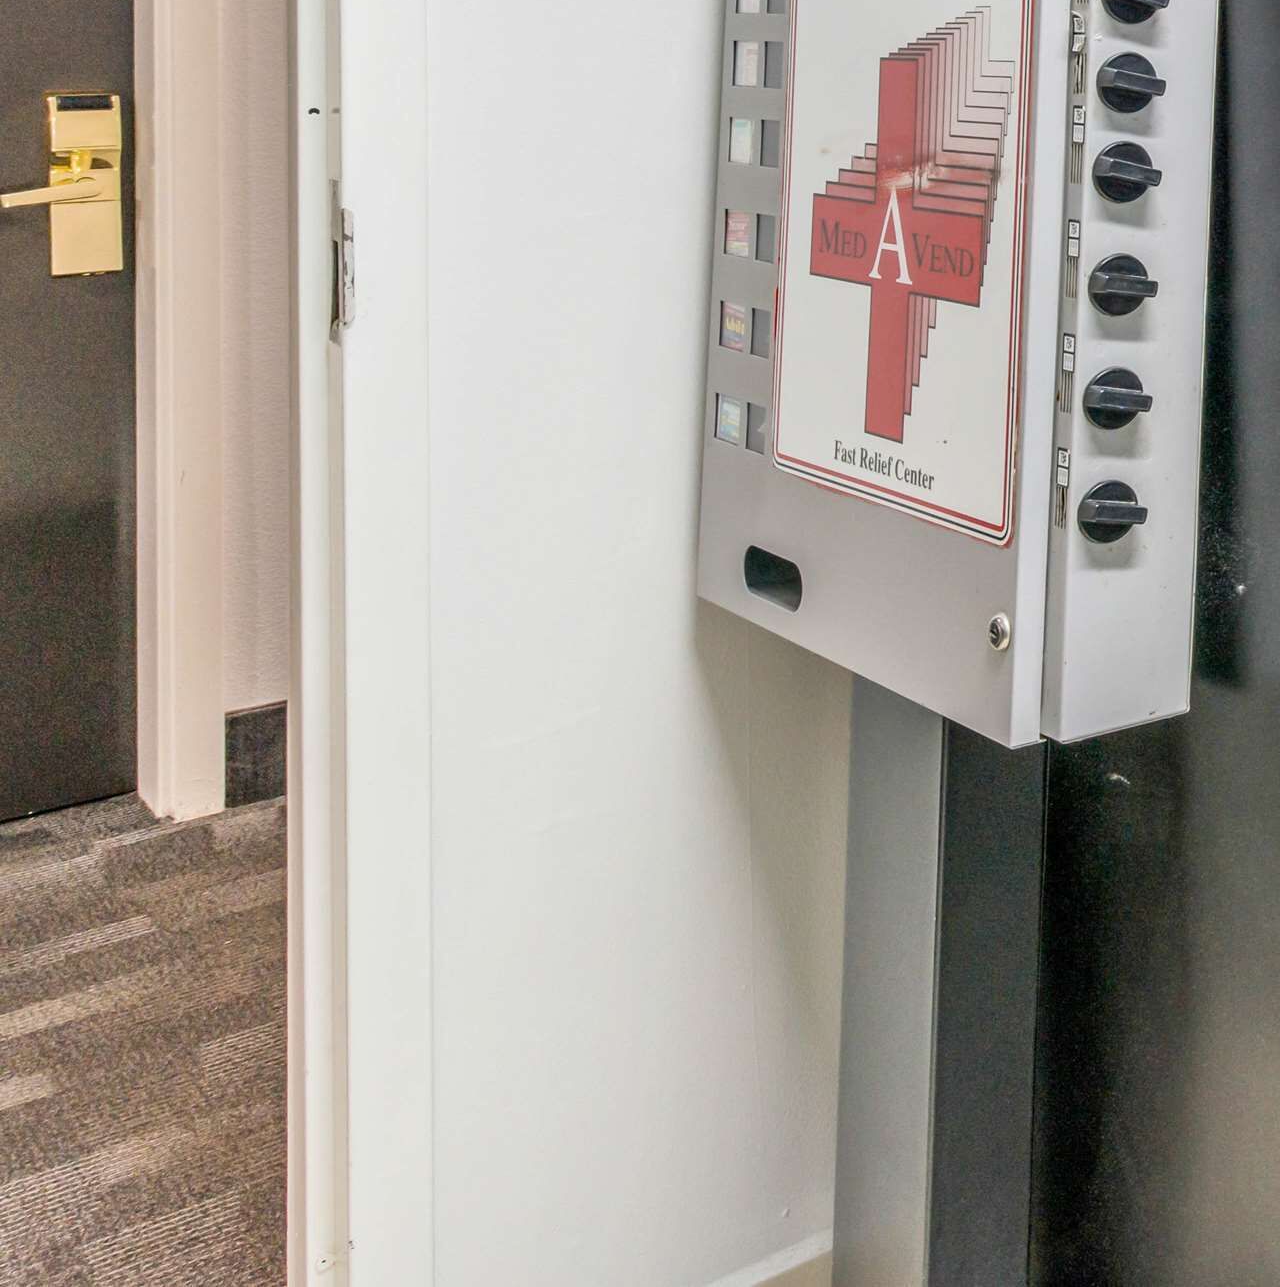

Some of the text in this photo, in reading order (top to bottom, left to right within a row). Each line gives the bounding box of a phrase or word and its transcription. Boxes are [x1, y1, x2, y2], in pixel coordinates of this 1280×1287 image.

[868, 186, 913, 285] A
[912, 233, 975, 278] VEND
[834, 439, 935, 491] Fast Relief Center
